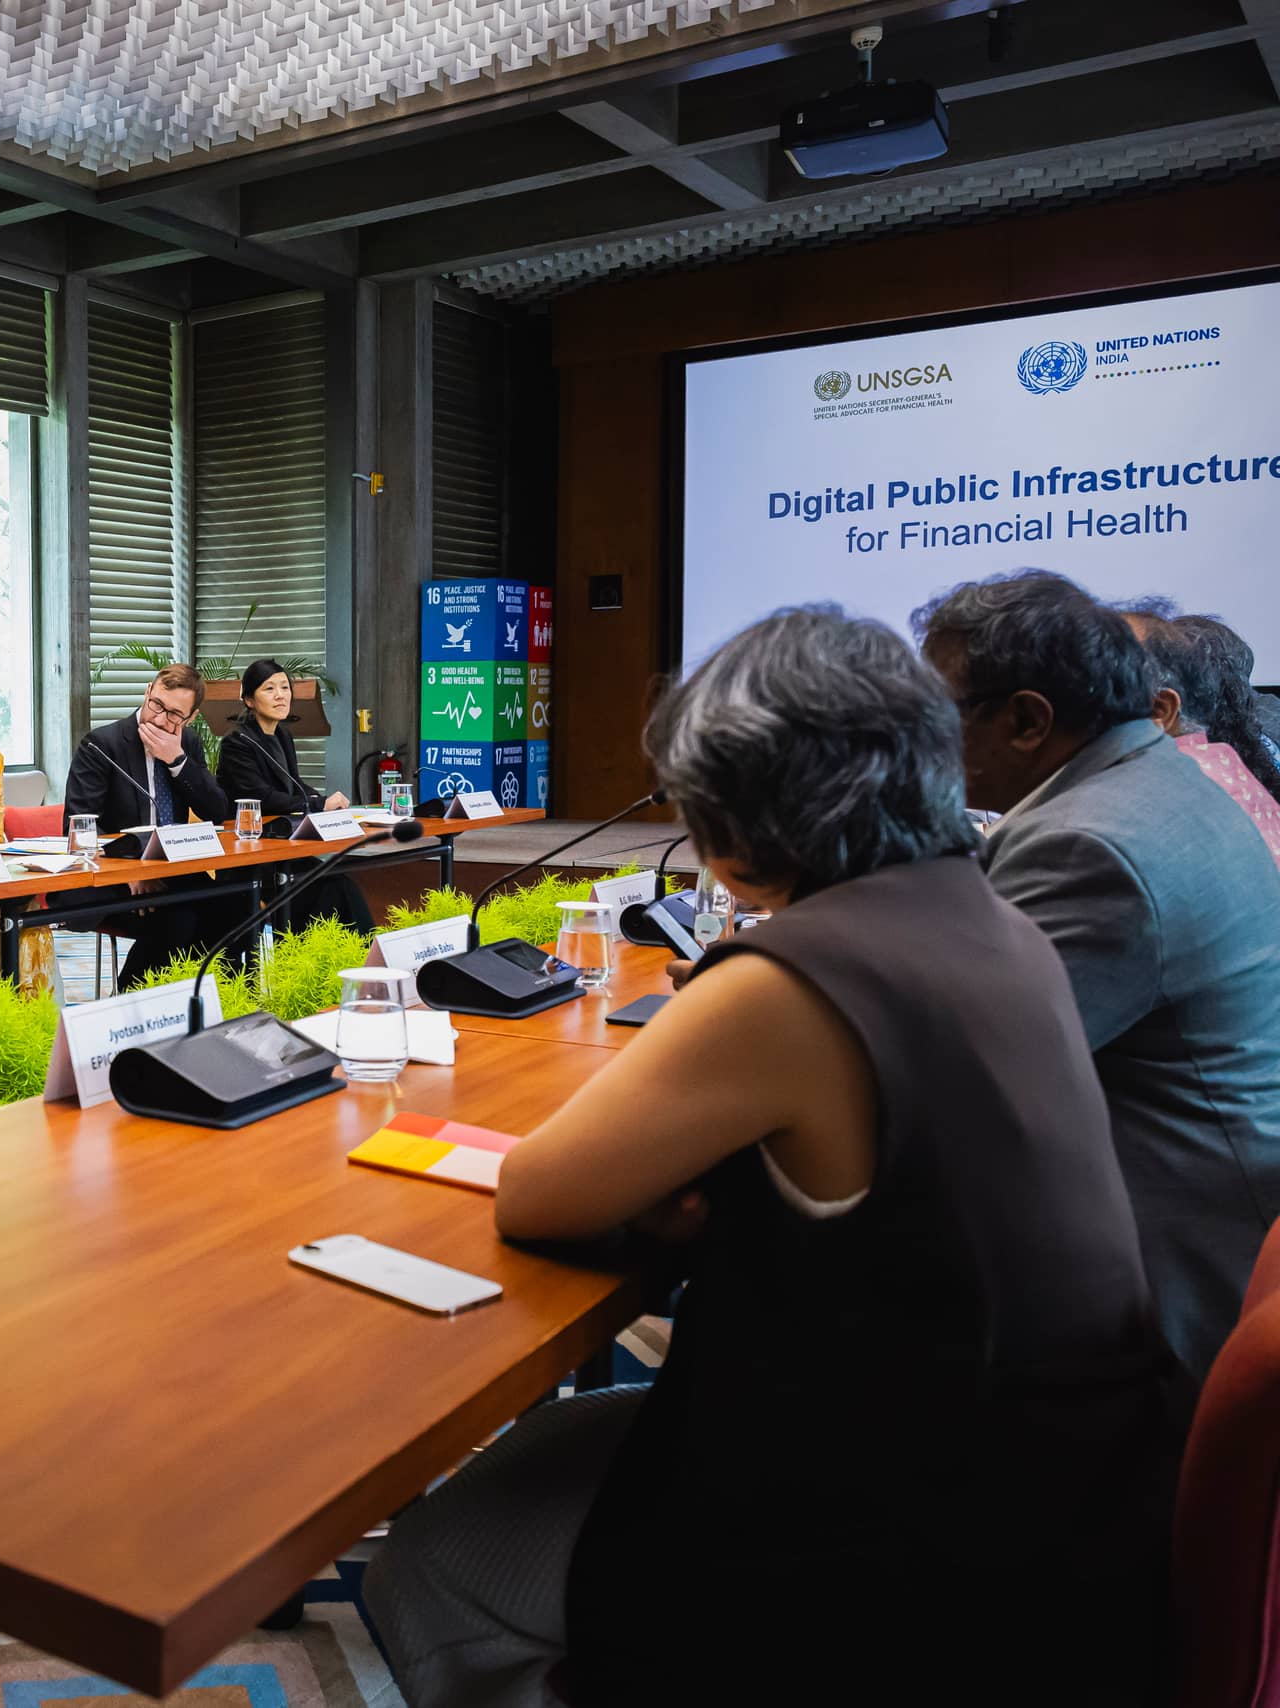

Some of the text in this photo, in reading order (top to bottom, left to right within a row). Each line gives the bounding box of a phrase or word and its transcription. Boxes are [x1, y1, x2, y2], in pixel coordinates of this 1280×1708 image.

[1096, 327, 1220, 353] UNITED NATIONS
[1095, 353, 1129, 366] INDIA
[857, 363, 953, 392] UNSGSA
[813, 405, 837, 414] UNITED
[837, 401, 868, 411] NATIONS
[814, 398, 953, 421] SPECIAL ADVOCATE FOR FINANCIAL HEALTH
[769, 483, 874, 523] Digital
[888, 474, 1000, 508] Public
[846, 502, 1188, 553] for Financial Health
[427, 587, 440, 605] 16
[463, 584, 487, 594] JUSTICE
[497, 585, 505, 603] 16
[444, 595, 478, 604] AND STRONG
[443, 604, 481, 614] INSTITUTIONS
[428, 667, 436, 685] 3
[441, 667, 478, 675] GOOD HEALTH
[496, 667, 502, 685] 3
[426, 747, 439, 765] 17
[463, 758, 481, 766] GOALS
[109, 1012, 186, 1043] Jyotsna Krishnan
